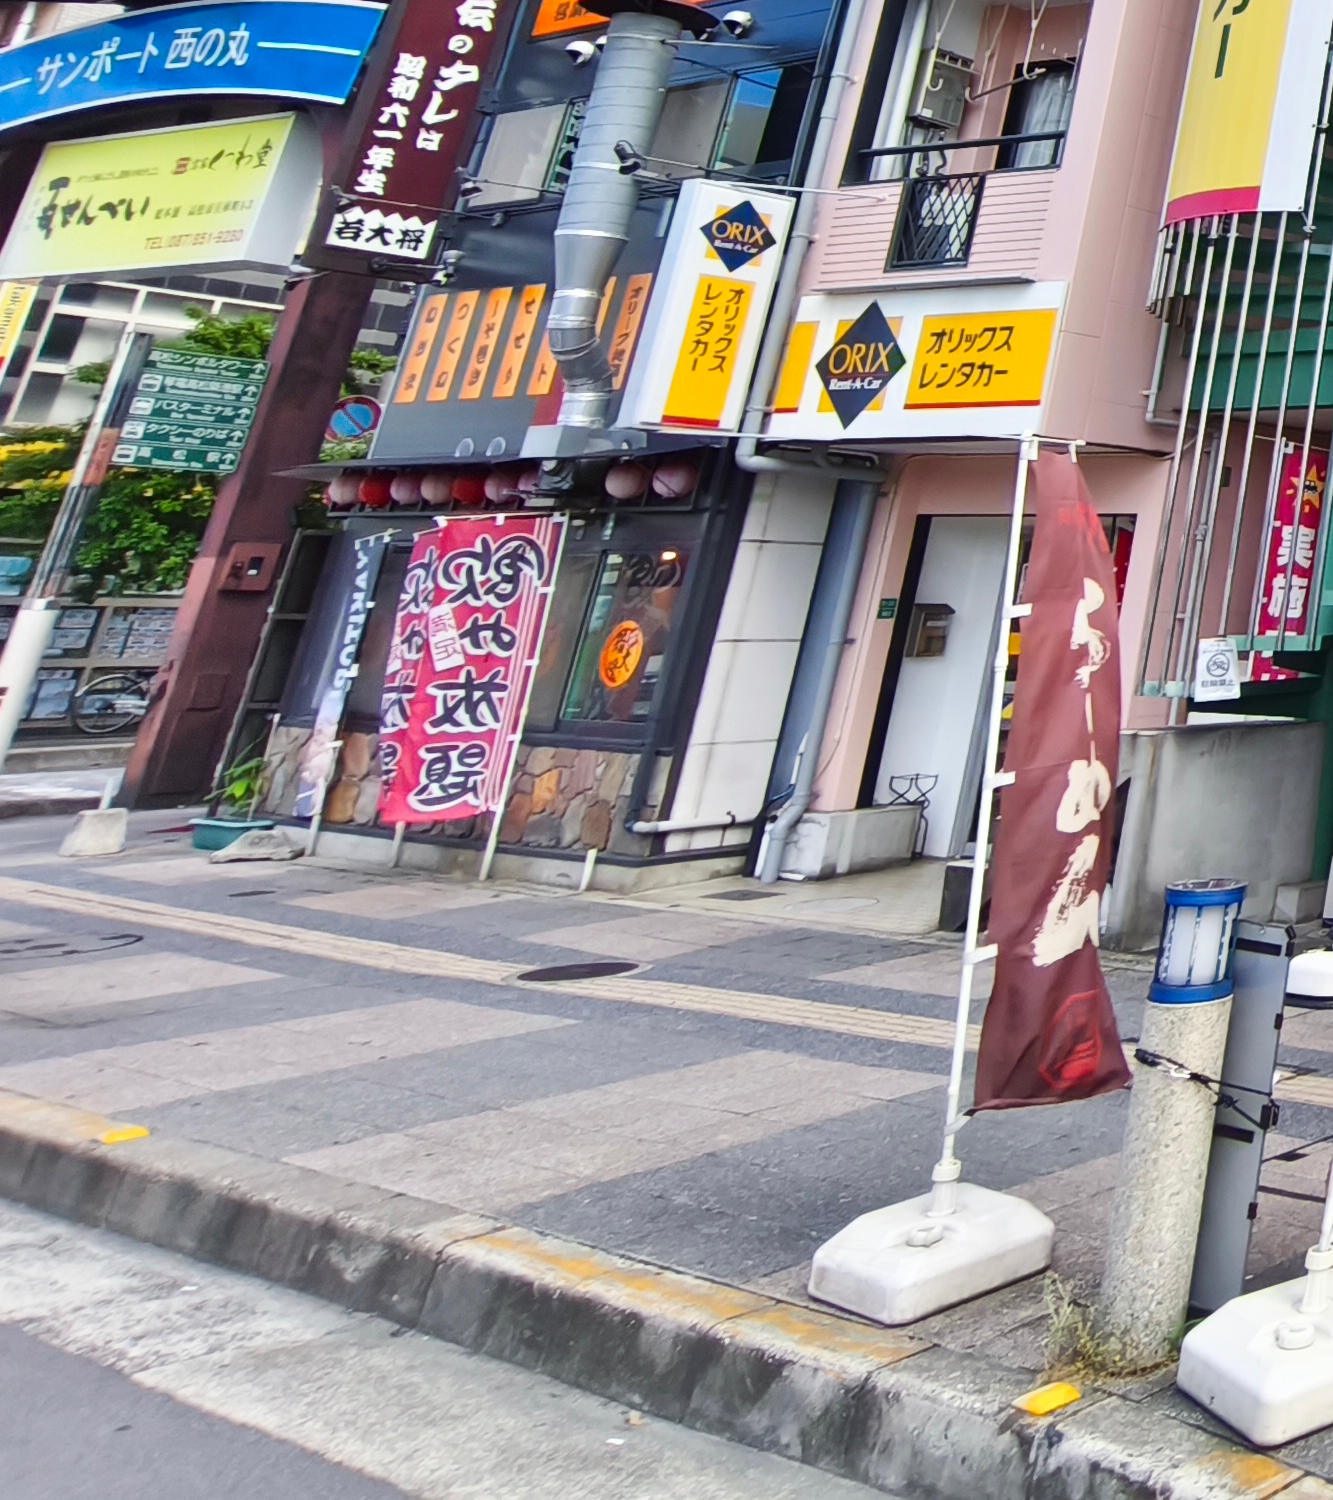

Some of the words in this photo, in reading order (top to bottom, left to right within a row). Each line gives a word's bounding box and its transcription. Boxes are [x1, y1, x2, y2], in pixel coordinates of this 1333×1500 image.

[354, 52, 425, 196] 昭和六一年生
[332, 218, 426, 253] 若大将
[711, 219, 765, 246] ORIX
[688, 282, 724, 372] レンタカー
[708, 287, 745, 374] オリックス
[925, 325, 1015, 356] オリックス
[828, 340, 895, 377] ORIX
[918, 361, 1009, 390] レンタカー
[155, 400, 236, 416] バスターミナル
